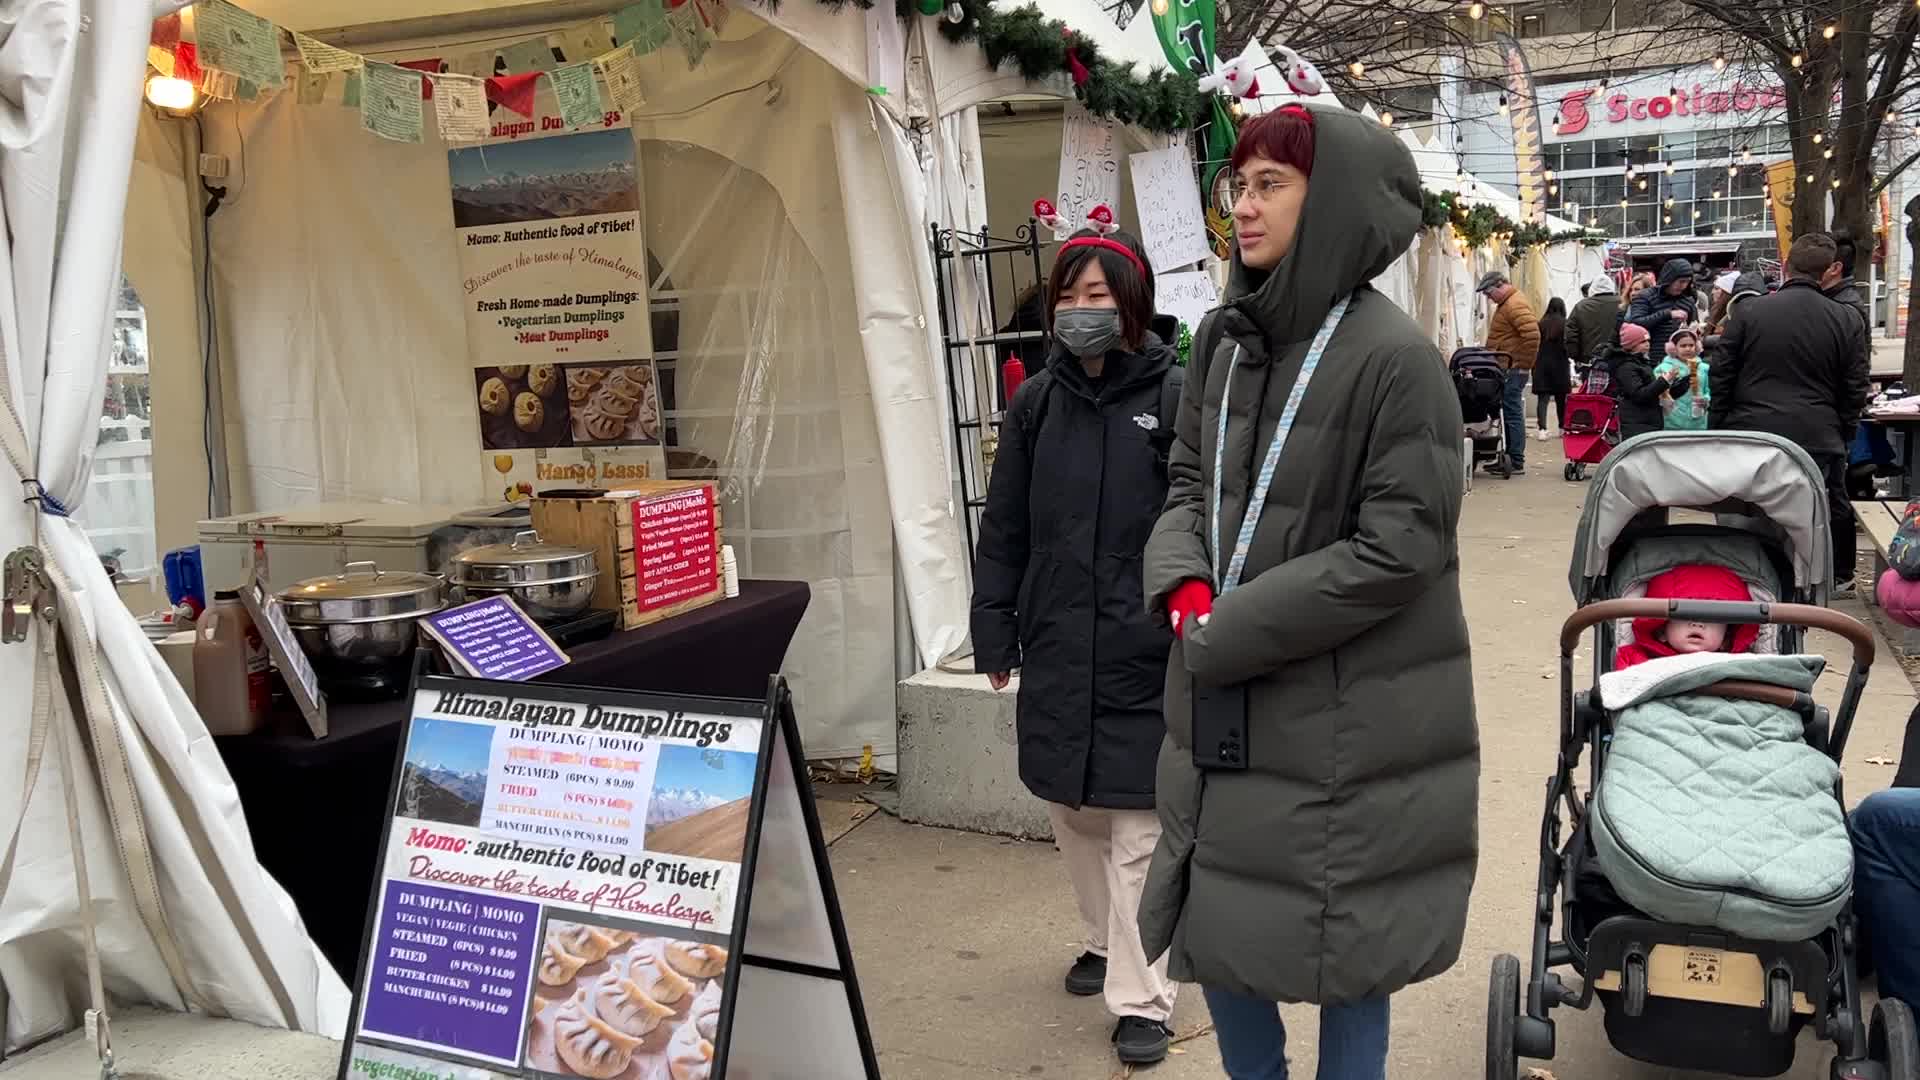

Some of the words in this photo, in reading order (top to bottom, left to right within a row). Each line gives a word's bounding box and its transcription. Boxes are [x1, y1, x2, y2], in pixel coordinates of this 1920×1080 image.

[1607, 82, 1843, 123] Scotiaba
[490, 121, 535, 138] alayan
[466, 233, 502, 246] Momo:
[503, 226, 558, 243] Authentic
[560, 223, 585, 237] food
[587, 221, 599, 234] of
[601, 219, 635, 234] Tibet!
[463, 262, 512, 294] Discover
[515, 251, 531, 268] the
[534, 252, 559, 264] taste
[562, 247, 575, 265] of
[477, 300, 507, 312] Fresh
[509, 293, 573, 309] Home-made
[575, 290, 640, 306] Dumplings:
[563, 309, 625, 326] Dumplings
[549, 327, 609, 343] Dumplings
[536, 463, 597, 484] Mango
[602, 460, 650, 479] Lassi
[656, 563, 673, 575] APPLE
[433, 690, 576, 727] Himalayan
[579, 703, 733, 748] Dumplings
[509, 727, 586, 746] DUMPLING
[599, 736, 645, 753] MOMO
[503, 764, 559, 780] STEAMED
[565, 772, 599, 786] (6PCS)
[500, 783, 537, 797] FRIED
[537, 807, 583, 821] CHICKEN
[495, 819, 560, 837] MANCHURIAN
[406, 826, 472, 854] Momo:
[474, 840, 576, 869] authentic
[577, 850, 626, 876] food
[629, 858, 654, 880] of
[655, 862, 721, 890] Tibet!
[408, 855, 490, 888] Discover
[492, 869, 526, 893] the
[528, 875, 579, 901] taste
[583, 883, 610, 913] of
[607, 882, 714, 929] Himalaya
[399, 892, 473, 915] DUMPLING
[481, 906, 525, 924] MOMO
[396, 912, 429, 926] VEGAN
[436, 917, 467, 933] VEGIE
[473, 925, 518, 942] CHICKEN
[392, 928, 448, 947] STEAMED
[452, 940, 485, 955] (6PCS)
[389, 947, 428, 963] FRIED
[386, 965, 426, 982] BUTTER
[426, 972, 470, 990] CHICKEN
[384, 982, 448, 1003] MANCHURIAN
[353, 1057, 439, 1080] vegetarian
